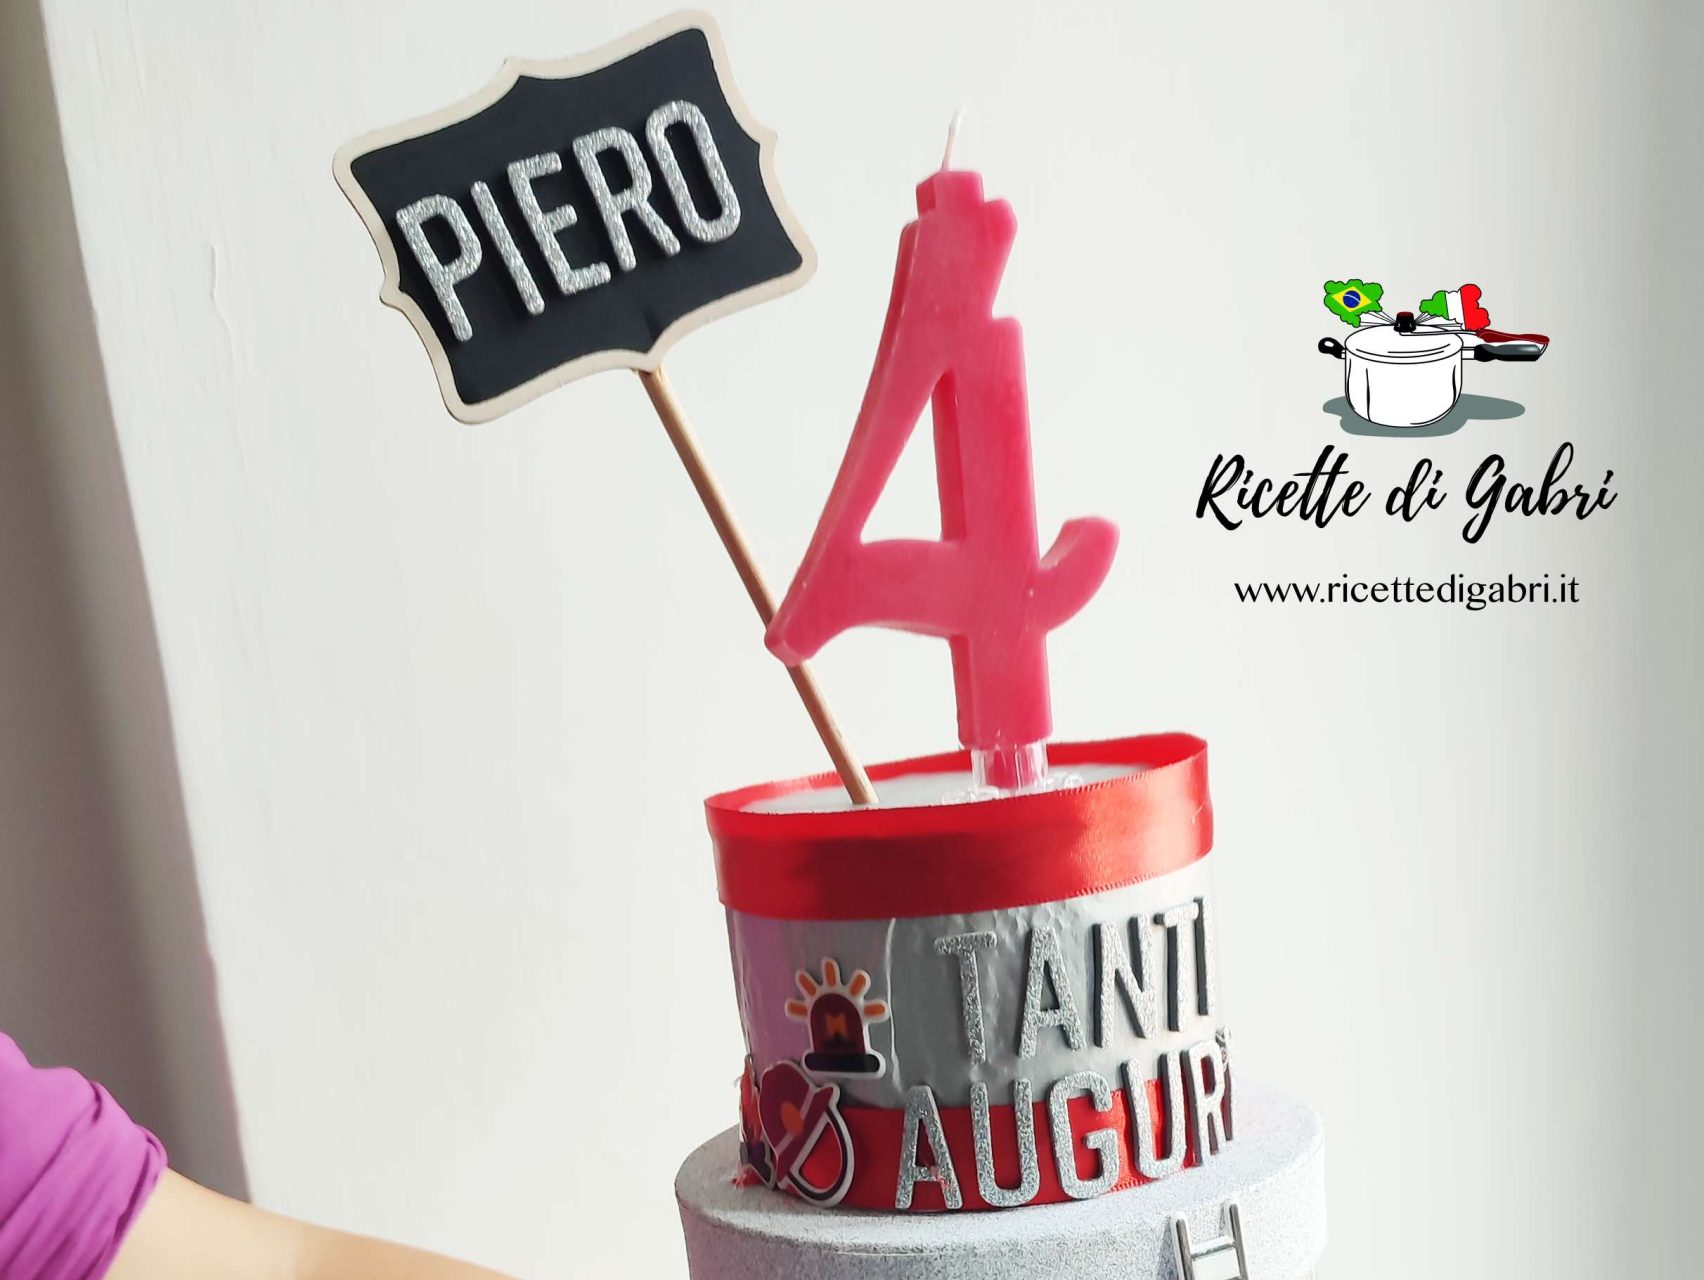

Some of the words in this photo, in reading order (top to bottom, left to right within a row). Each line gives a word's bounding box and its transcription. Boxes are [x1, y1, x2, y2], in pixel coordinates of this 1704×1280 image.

[395, 99, 742, 342] PIERO
[764, 170, 1120, 748] 4
[934, 897, 1216, 1064] TANTI
